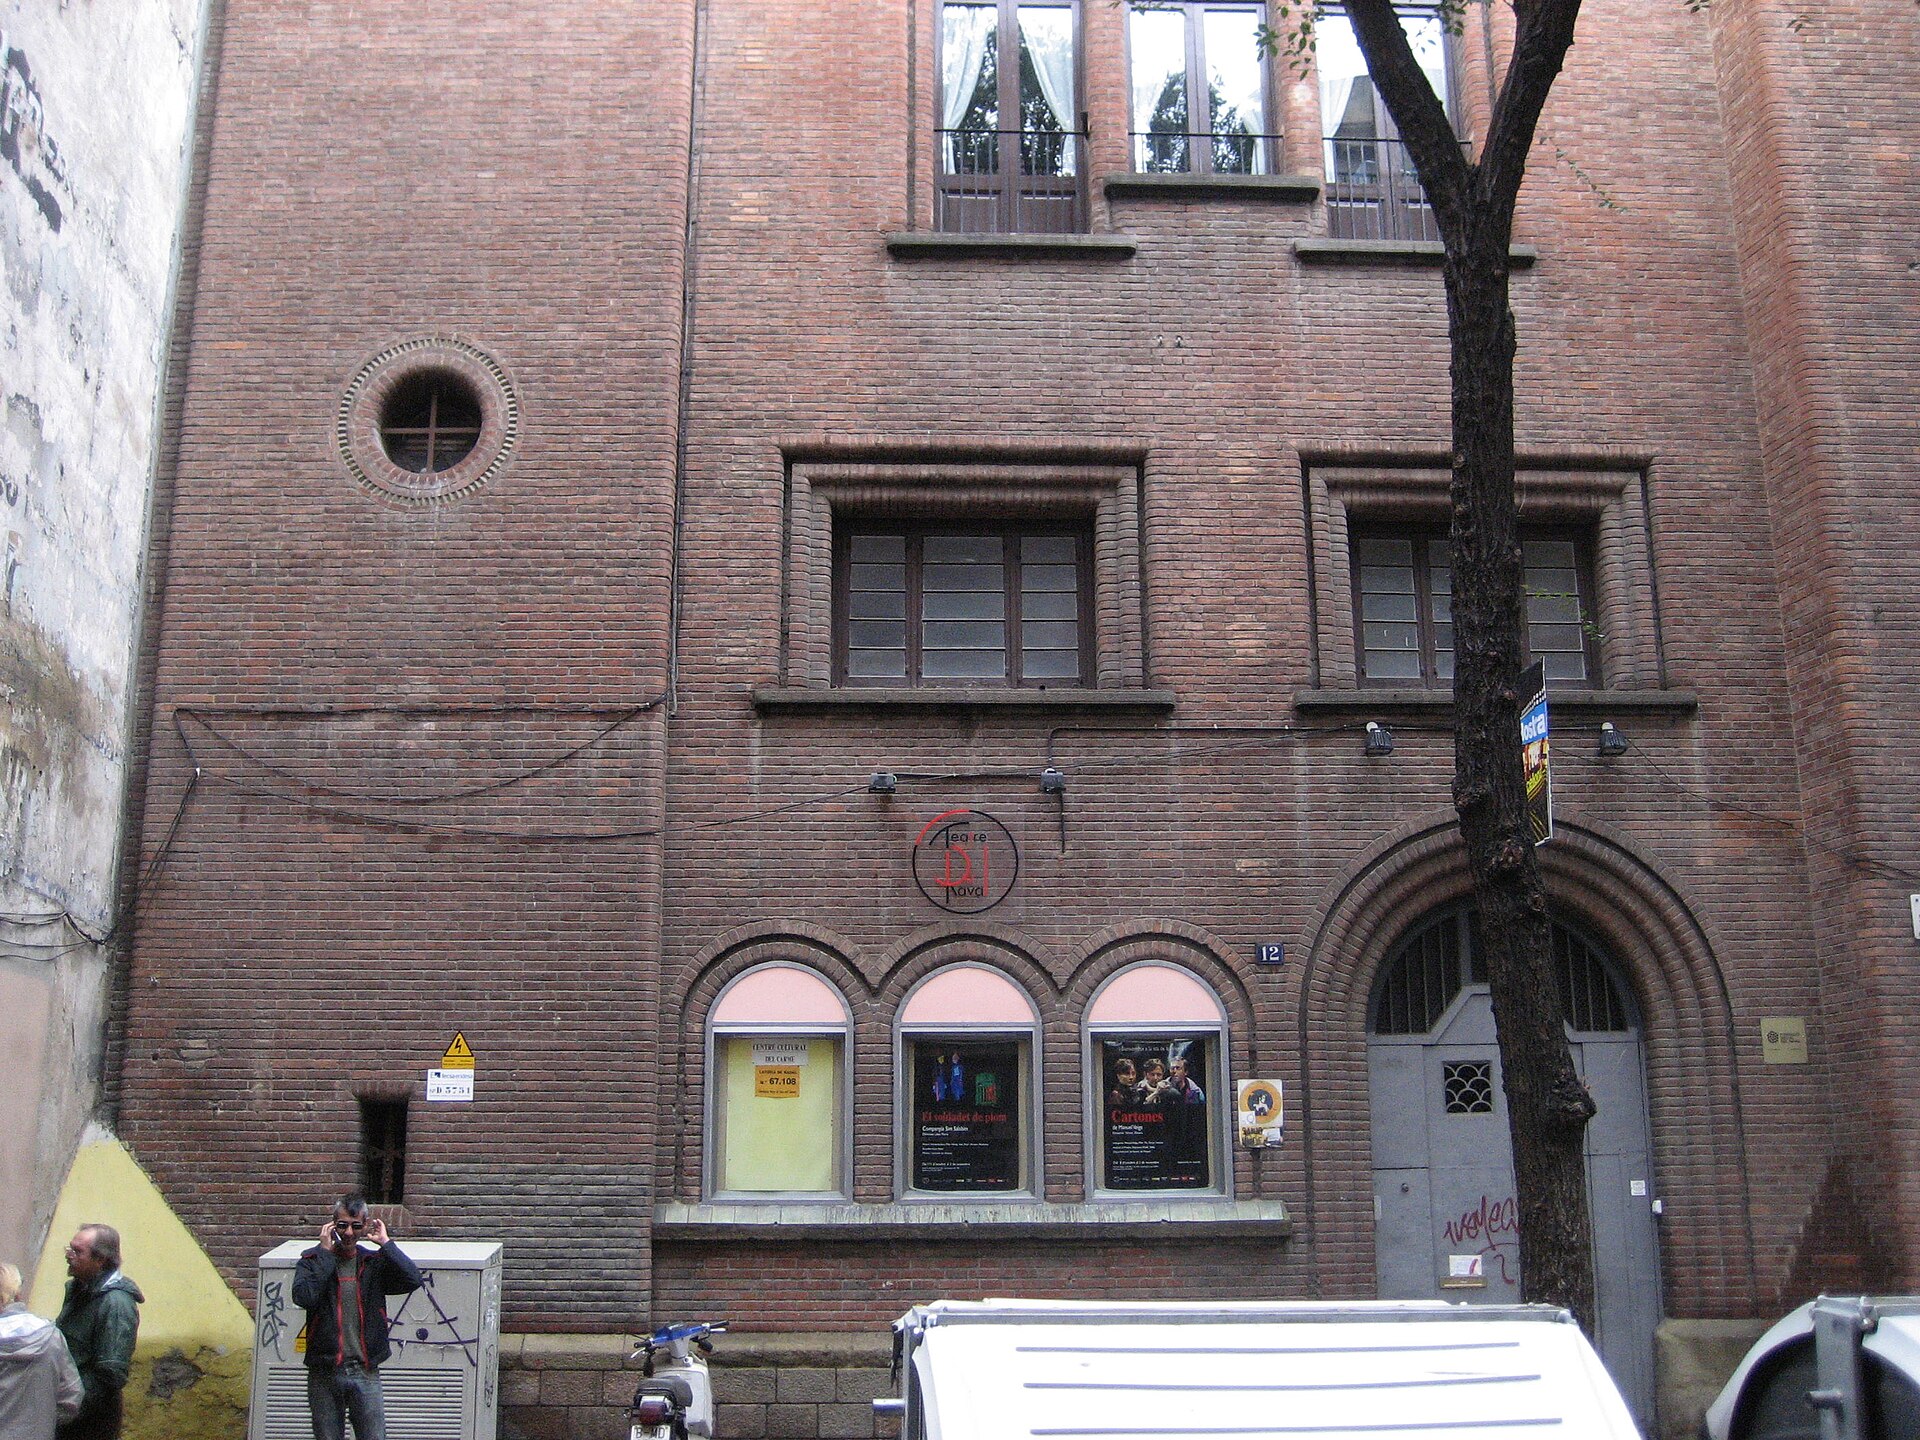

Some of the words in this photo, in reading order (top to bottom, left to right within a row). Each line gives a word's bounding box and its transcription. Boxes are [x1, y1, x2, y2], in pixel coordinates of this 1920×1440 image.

[929, 821, 987, 849] Teatre
[1261, 946, 1280, 961] 12
[1111, 1110, 1165, 1123] Cartones
